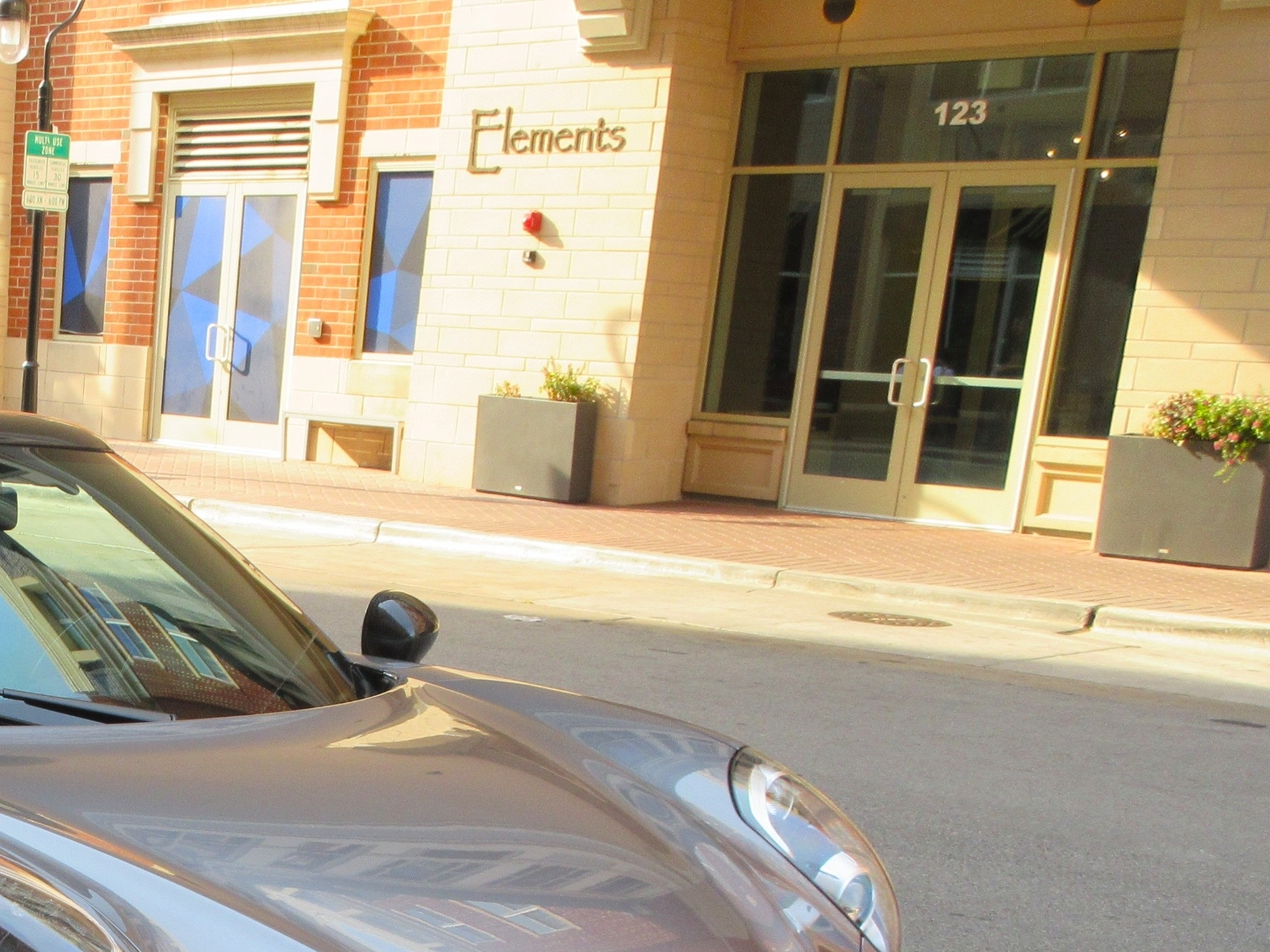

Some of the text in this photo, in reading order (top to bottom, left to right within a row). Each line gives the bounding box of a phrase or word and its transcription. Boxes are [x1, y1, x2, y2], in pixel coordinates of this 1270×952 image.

[934, 100, 987, 126] 123
[52, 137, 63, 147] USE
[467, 106, 627, 175] Elements
[41, 146, 55, 155] ZONE
[33, 171, 40, 179] 15
[53, 173, 61, 182] 30
